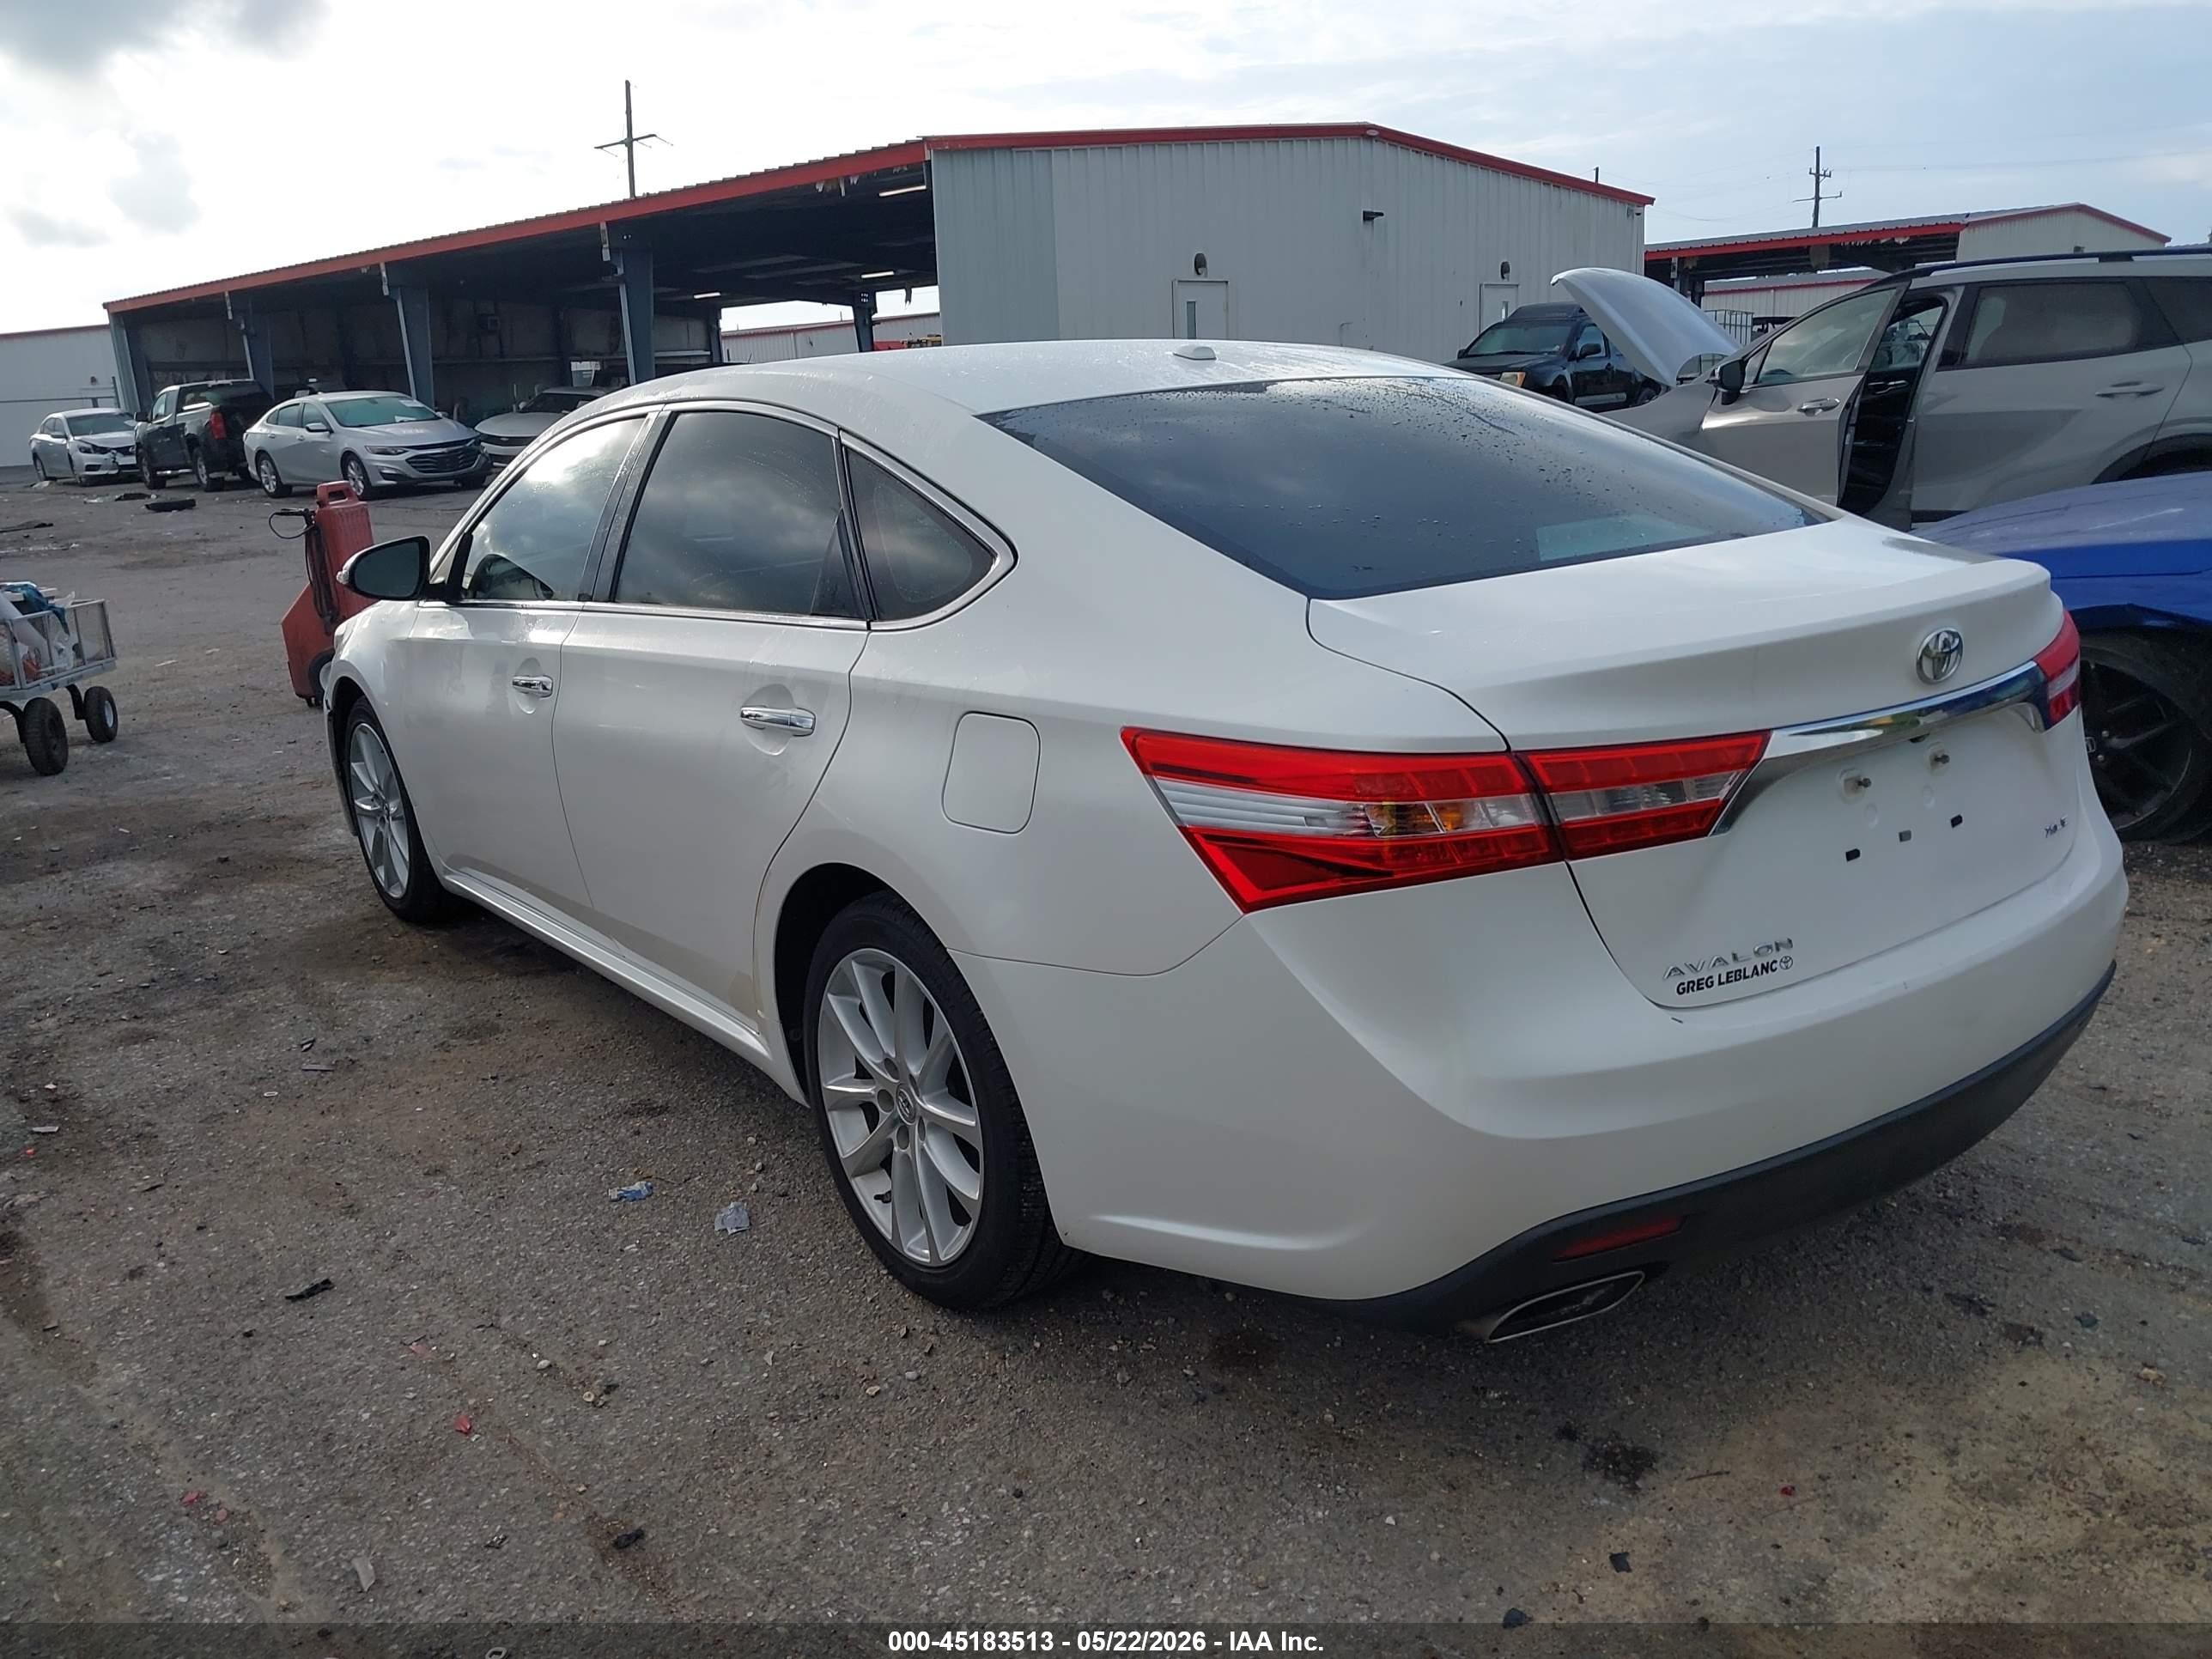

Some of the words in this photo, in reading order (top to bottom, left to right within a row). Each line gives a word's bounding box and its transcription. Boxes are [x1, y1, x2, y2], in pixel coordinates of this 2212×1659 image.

[1663, 938, 1794, 980] AVALON
[1676, 975, 1715, 996] GREG
[1717, 958, 1778, 987] LEBLANC
